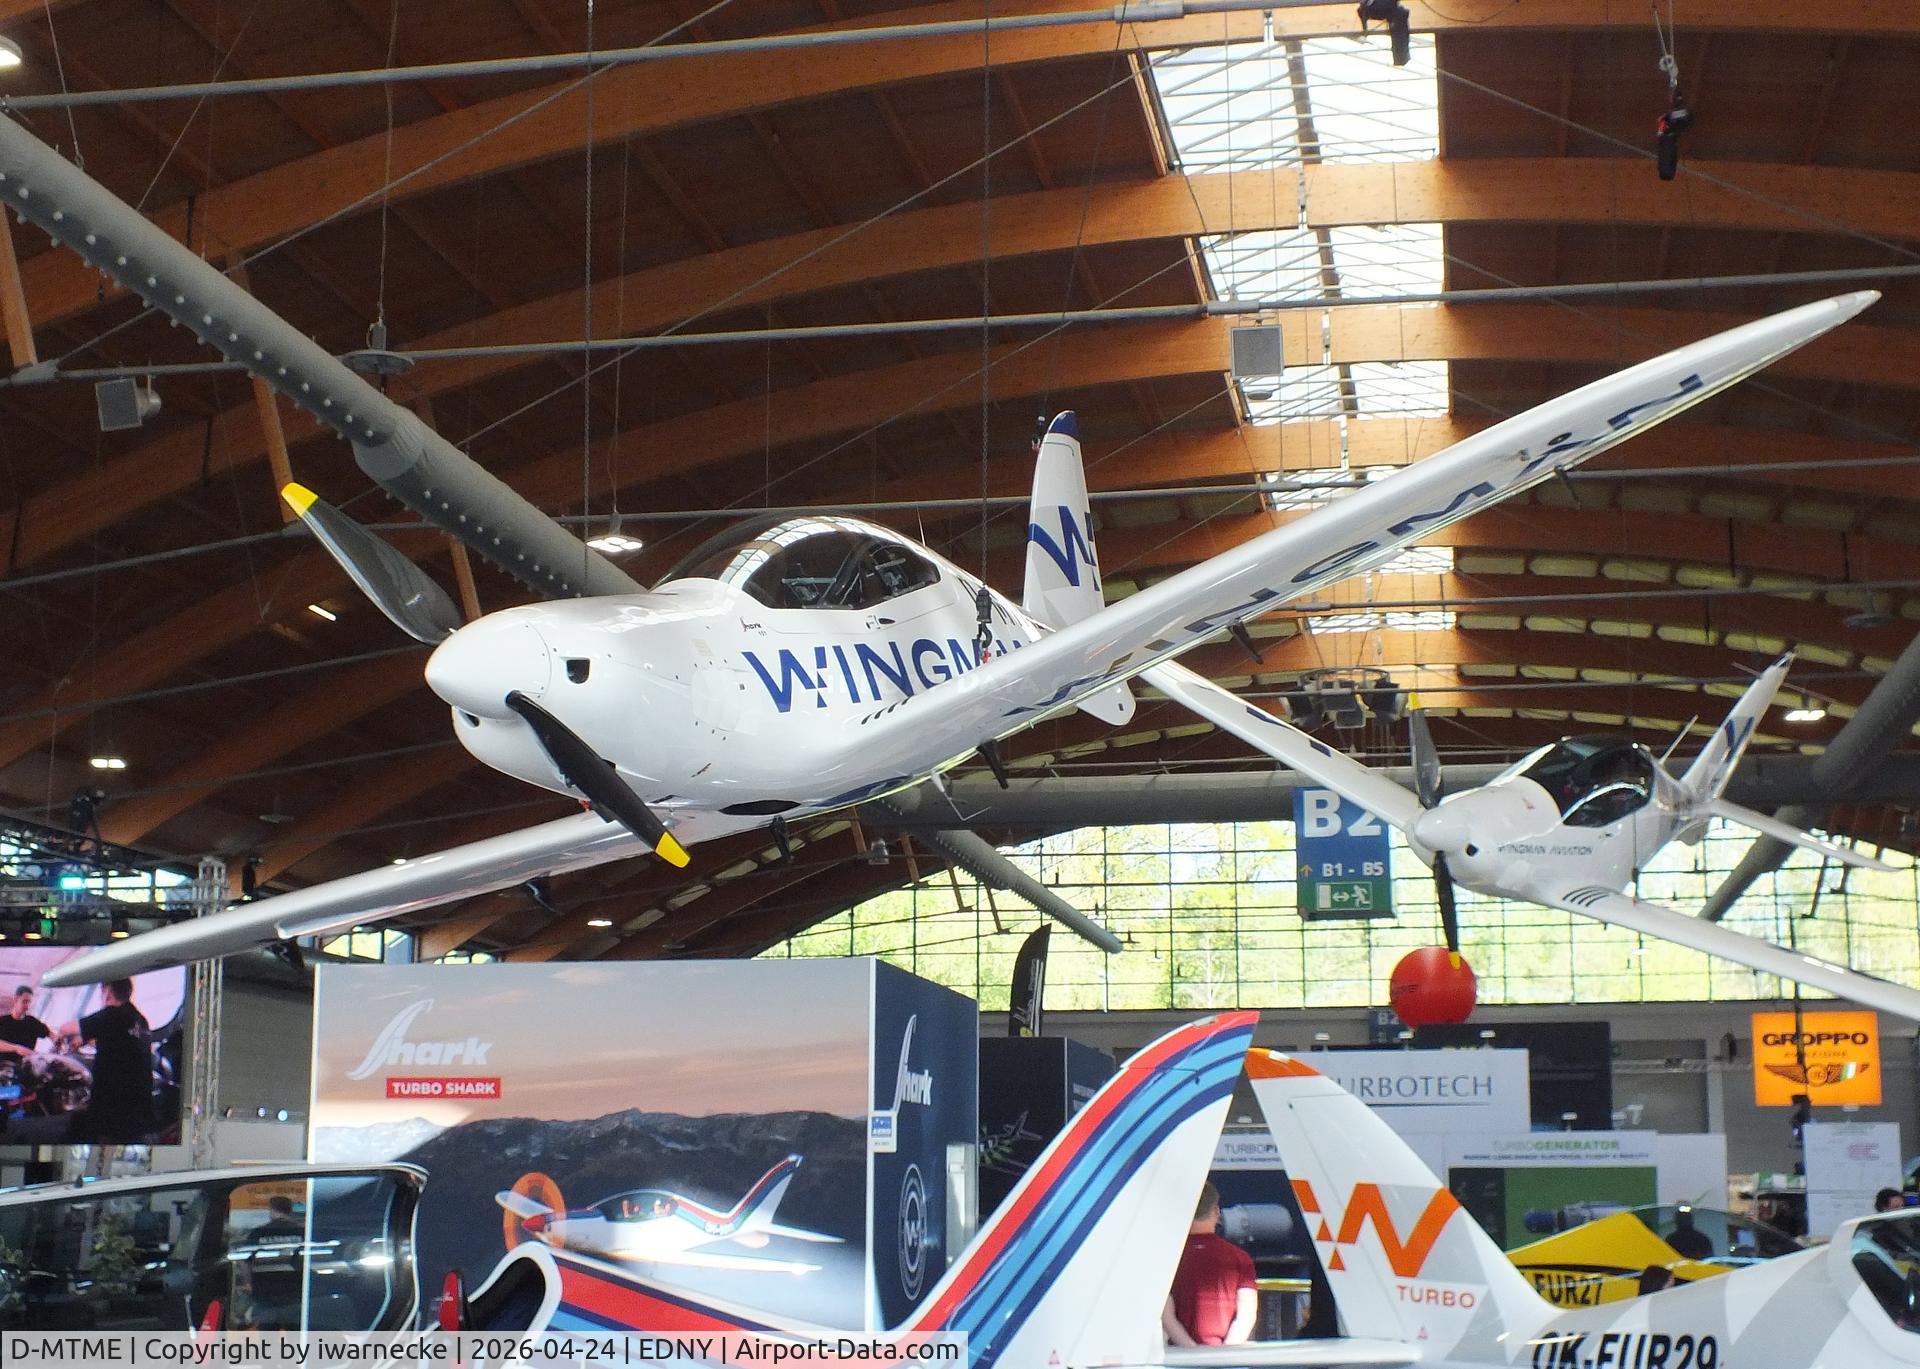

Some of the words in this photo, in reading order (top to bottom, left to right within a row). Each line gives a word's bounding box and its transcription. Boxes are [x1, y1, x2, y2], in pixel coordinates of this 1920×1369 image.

[741, 639, 1022, 713] WINGM
[1321, 862, 1343, 877] B1
[1361, 861, 1384, 876] B5
[1762, 1032, 1869, 1046] GROPPO
[392, 1082, 442, 1095] TURBO
[445, 1082, 496, 1095] SHARK
[1334, 1075, 1492, 1098] URBOTECH
[1396, 1284, 1475, 1309] TURBO
